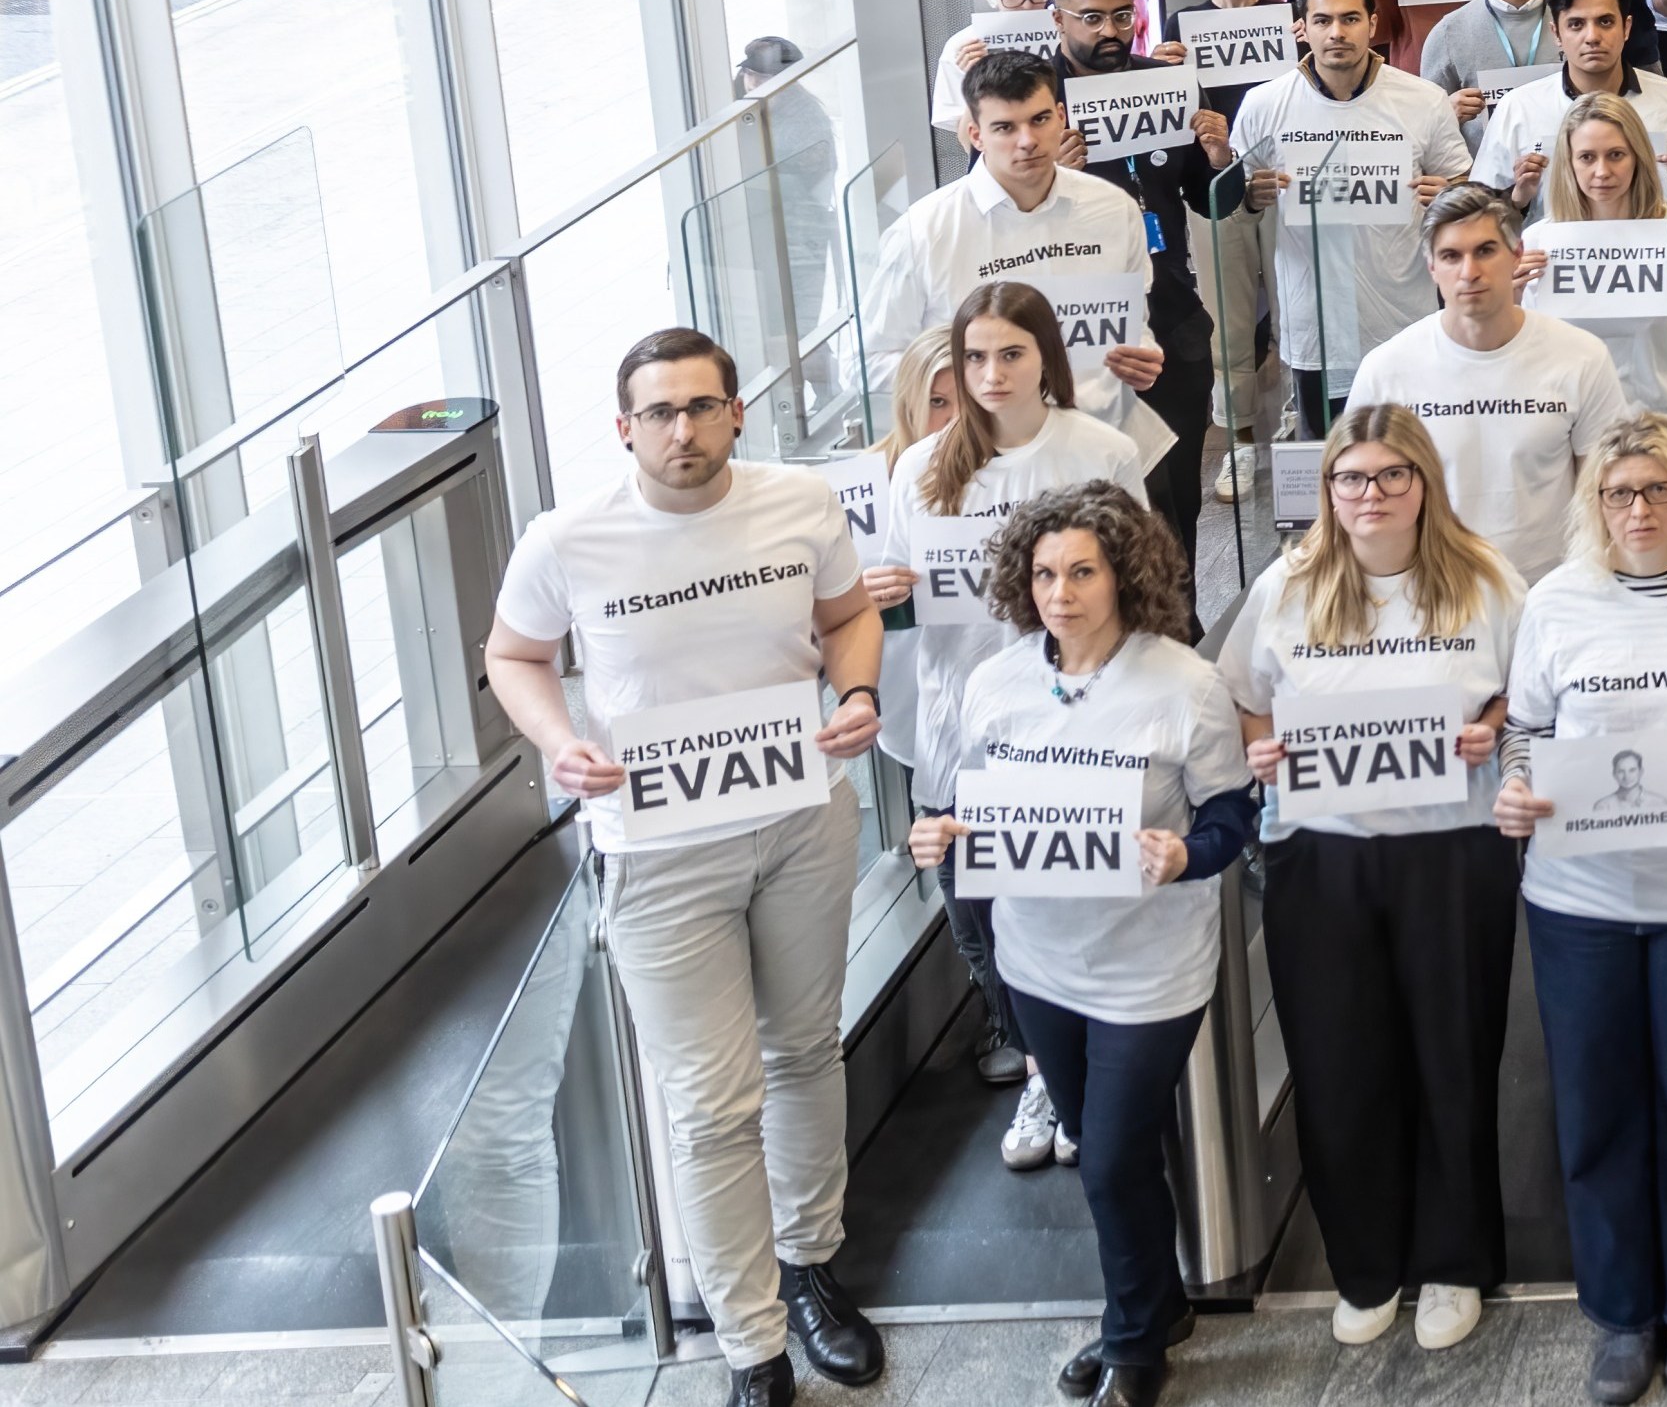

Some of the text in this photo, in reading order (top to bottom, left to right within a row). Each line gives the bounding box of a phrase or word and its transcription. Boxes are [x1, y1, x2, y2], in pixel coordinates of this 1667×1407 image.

[1191, 26, 1283, 42] #ISTANDWITH
[1195, 38, 1284, 69] EVAN
[1550, 247, 1666, 260] #ISTANDWITH
[1553, 264, 1663, 294] EVAN
[604, 562, 808, 618] #IStandWithEvan
[622, 717, 802, 764] #ISTANDWITH
[1278, 716, 1445, 748] #ISTANDWITH
[627, 741, 804, 812] EVAN
[1286, 737, 1446, 792] EVAN
[962, 806, 1123, 824] #ISTANDWITH
[964, 830, 1120, 870] EVAN
